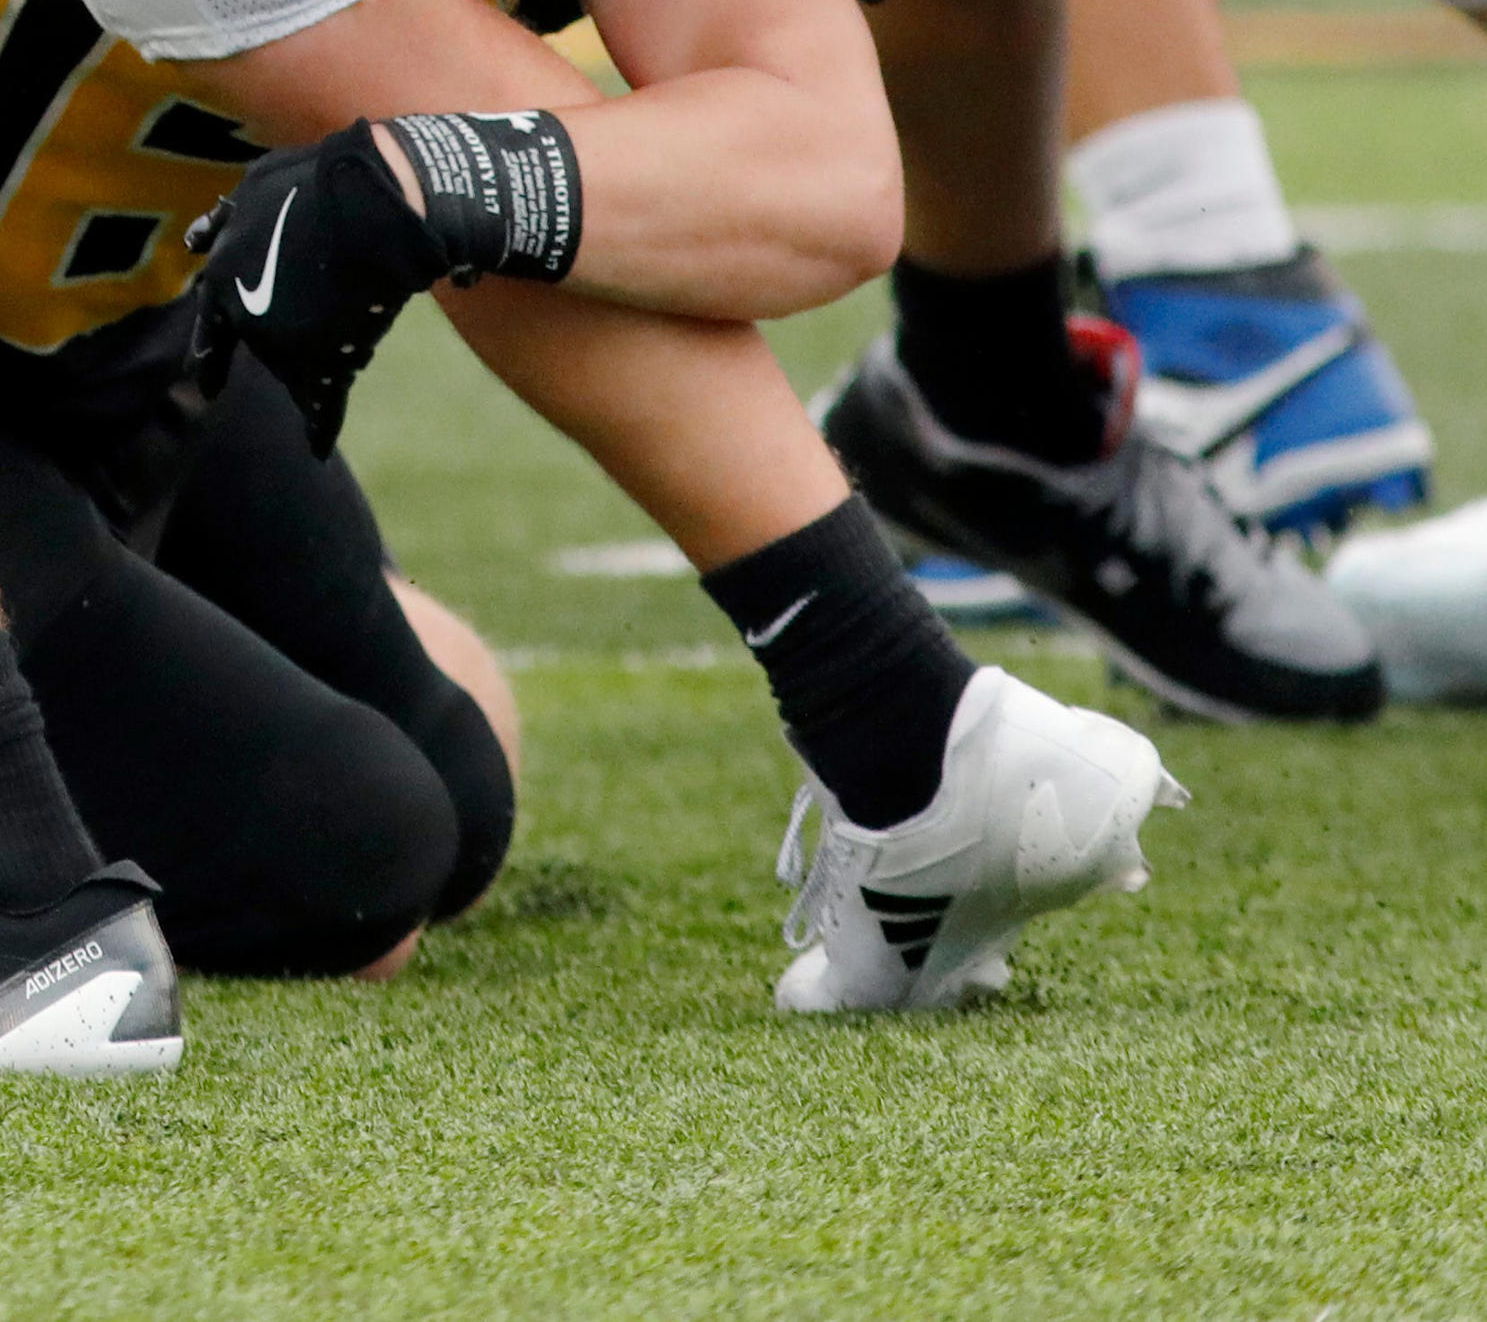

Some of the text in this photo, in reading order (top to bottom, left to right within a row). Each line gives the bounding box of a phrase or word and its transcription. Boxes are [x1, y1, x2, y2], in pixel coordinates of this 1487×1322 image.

[483, 188, 501, 216] 1:7
[546, 147, 571, 246] TIMOTHY
[26, 941, 104, 1000] ADIZERO
